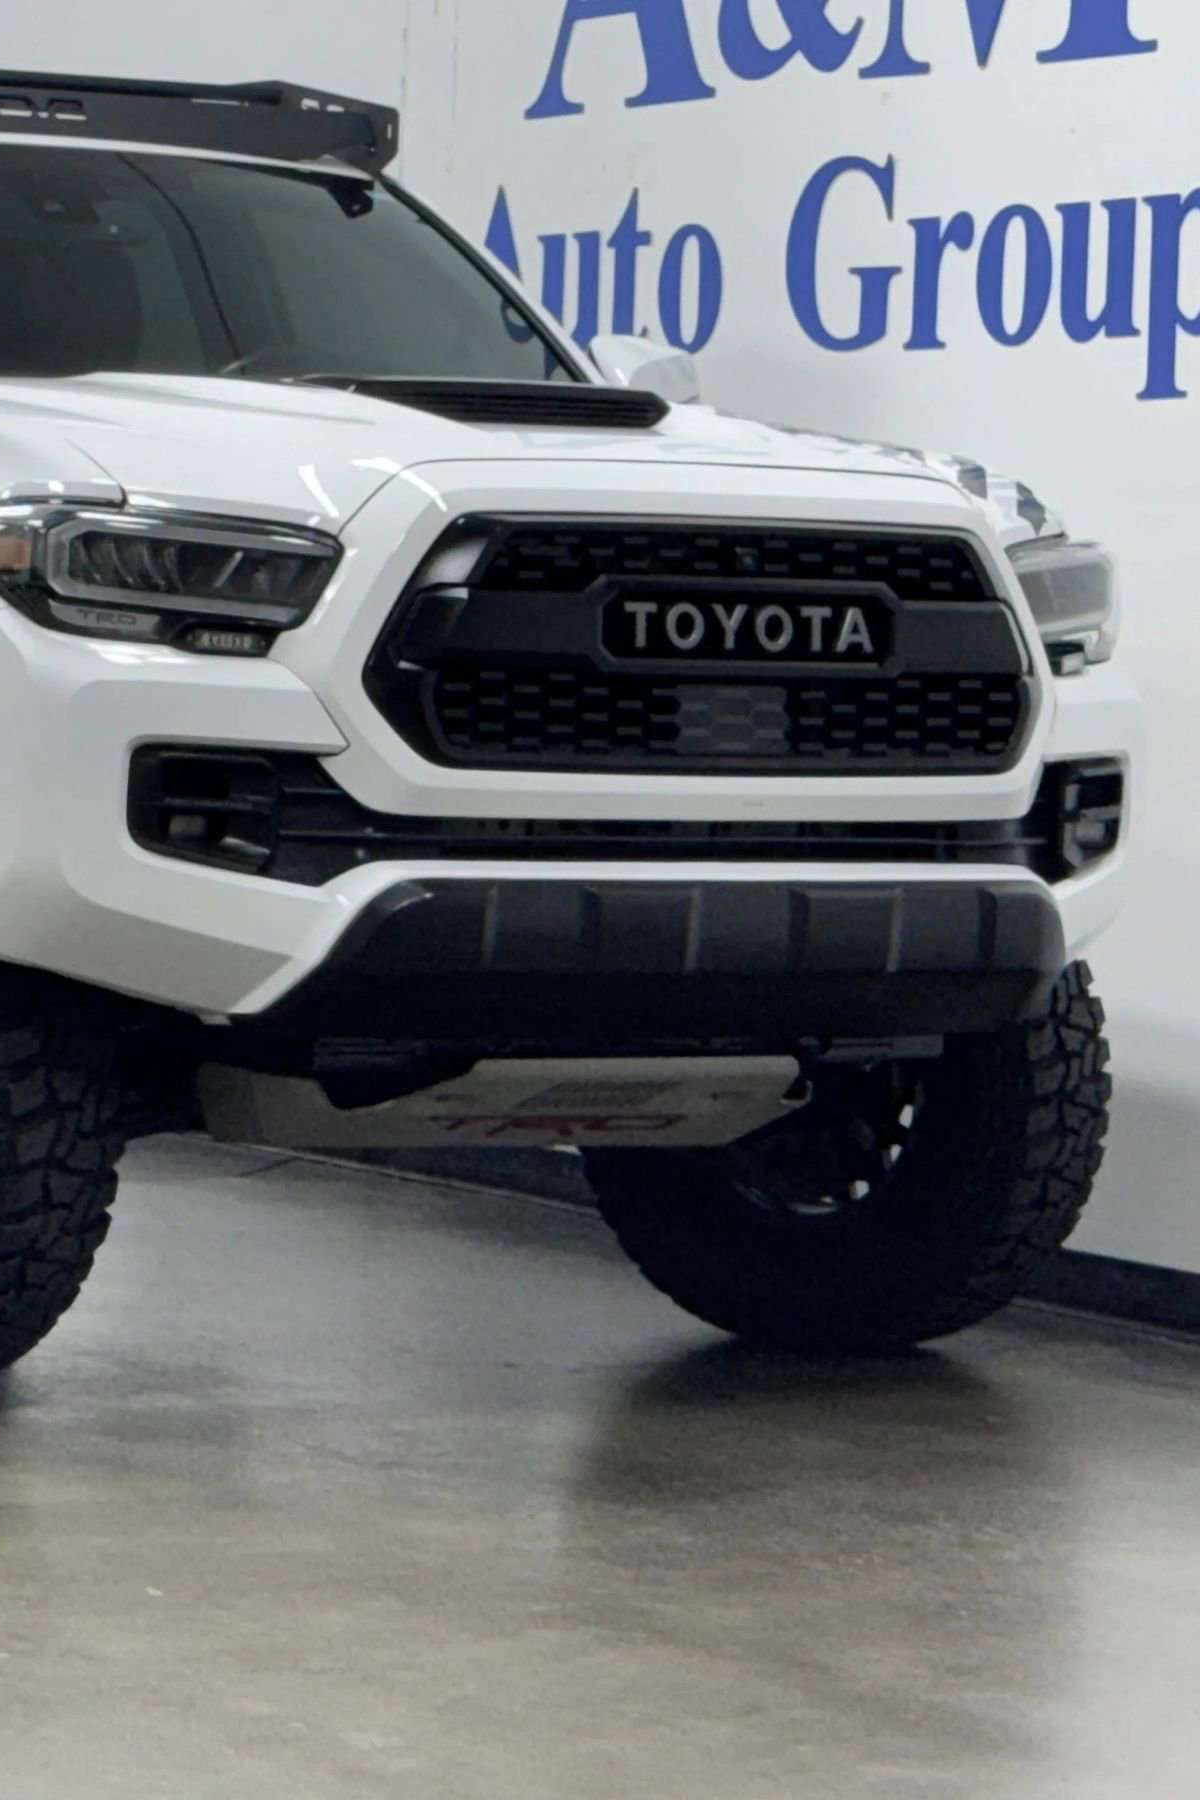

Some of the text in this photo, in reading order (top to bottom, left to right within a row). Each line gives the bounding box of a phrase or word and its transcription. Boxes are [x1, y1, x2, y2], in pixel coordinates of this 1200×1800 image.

[785, 153, 1200, 401] Group
[76, 606, 138, 626] TRD
[623, 601, 874, 654] TOYOTA
[428, 1113, 690, 1139] TRD
